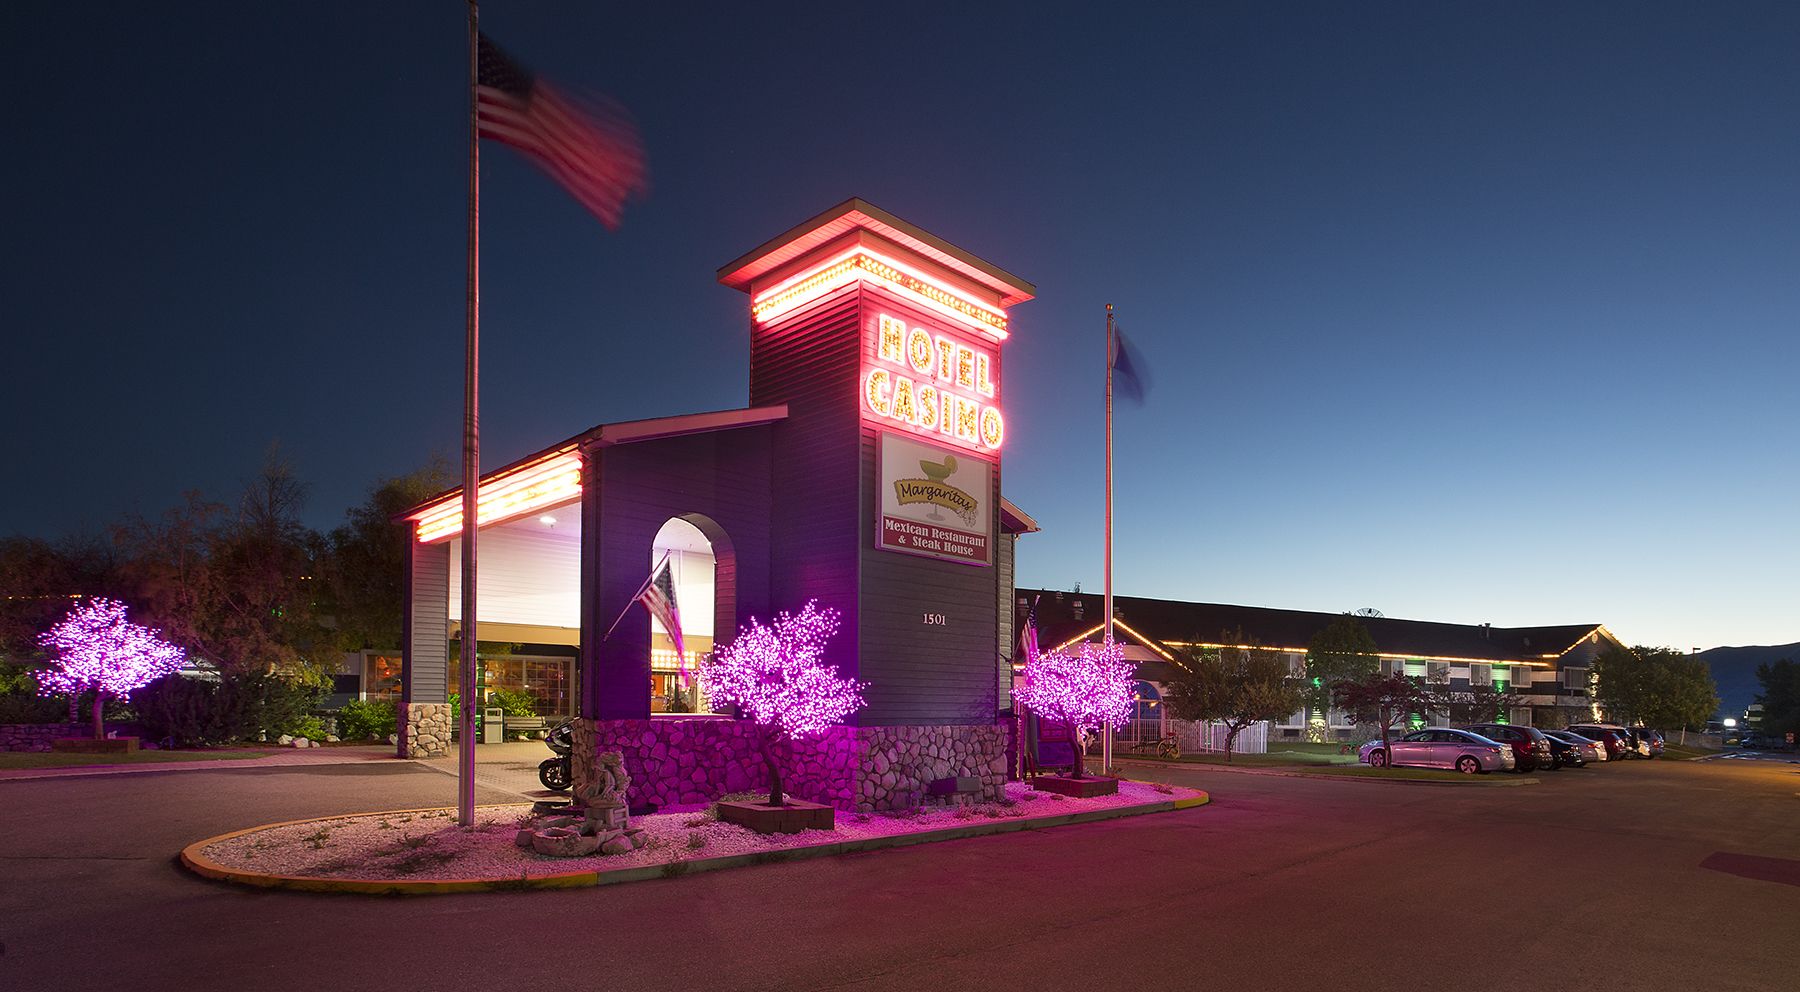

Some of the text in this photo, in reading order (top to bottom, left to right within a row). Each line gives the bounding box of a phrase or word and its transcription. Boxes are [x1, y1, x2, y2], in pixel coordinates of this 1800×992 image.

[877, 313, 994, 398] HOTEL
[865, 368, 1004, 449] CASINO
[900, 483, 972, 511] Margaritas
[885, 519, 985, 547] Mexican Restaurant
[898, 535, 974, 556] & Steak House
[923, 613, 946, 626] 1501
